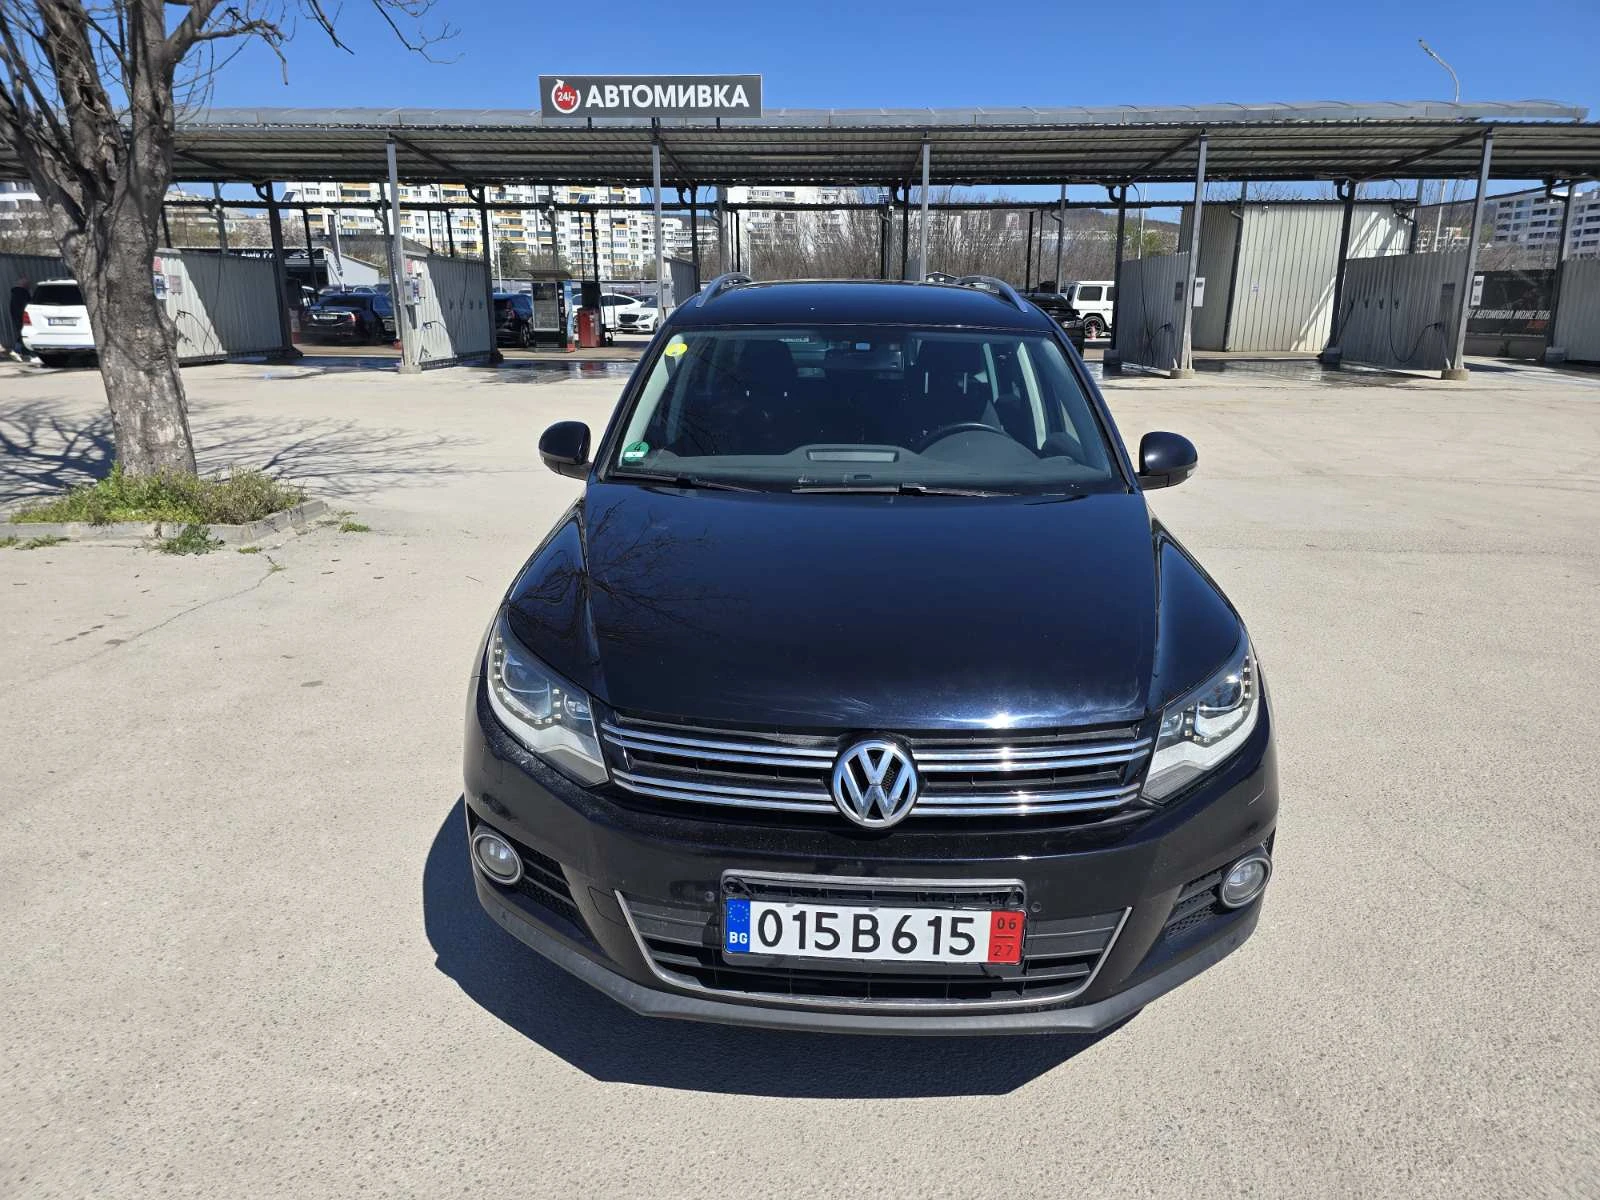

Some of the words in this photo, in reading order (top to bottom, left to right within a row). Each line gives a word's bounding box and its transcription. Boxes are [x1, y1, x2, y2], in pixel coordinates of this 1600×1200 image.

[557, 91, 576, 106] 24/7
[585, 84, 750, 108] АВТОМИВКА
[835, 741, 916, 827] VW
[729, 931, 748, 944] BG
[758, 909, 976, 957] 015B615
[997, 917, 1017, 930] 06
[993, 944, 1014, 957] 27
